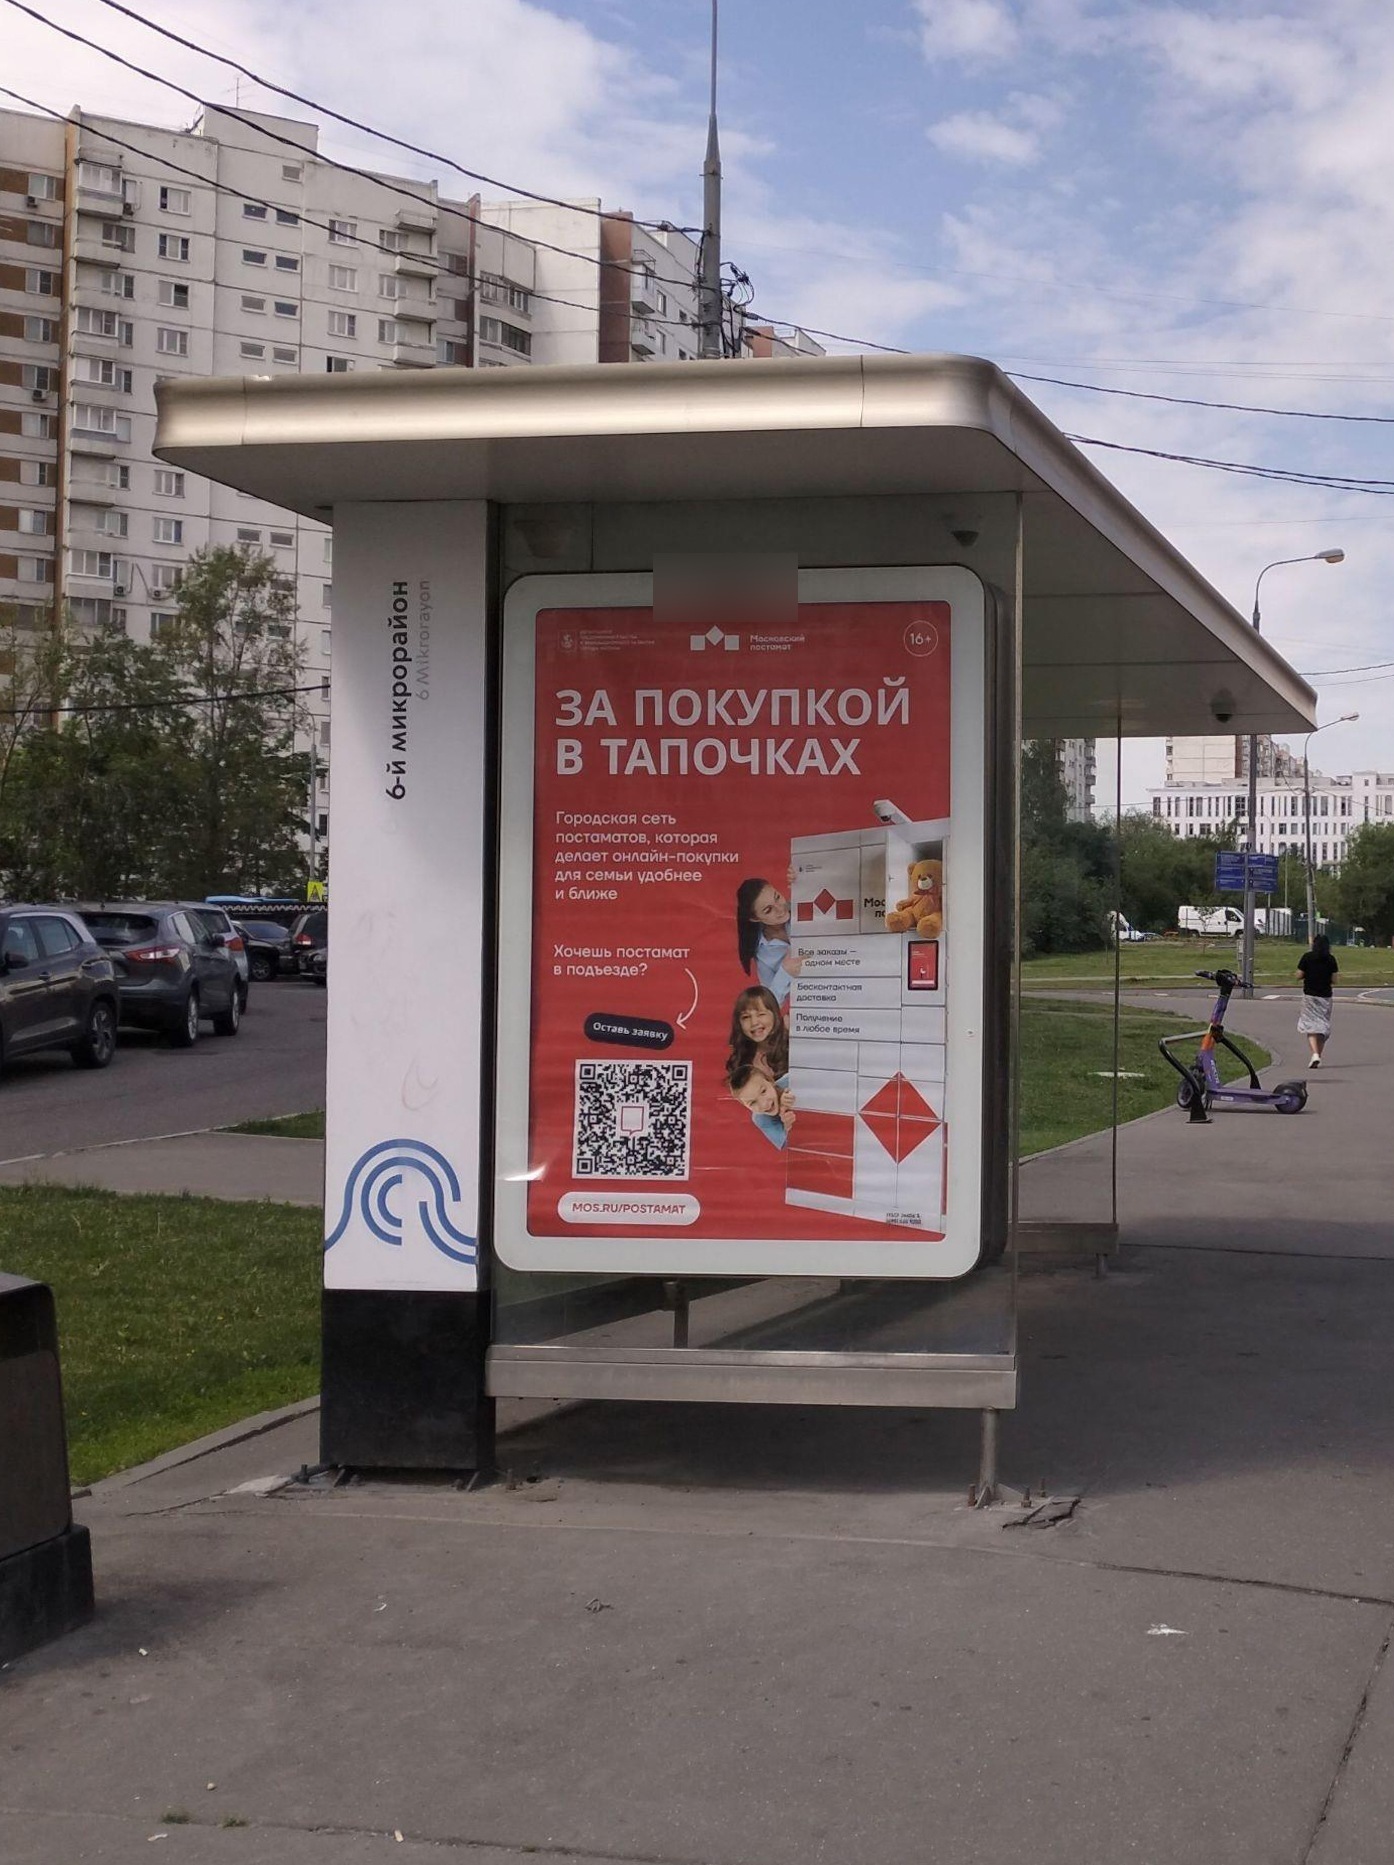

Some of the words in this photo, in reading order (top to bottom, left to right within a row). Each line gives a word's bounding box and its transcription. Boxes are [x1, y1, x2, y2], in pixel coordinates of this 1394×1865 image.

[416, 580, 433, 686] Mikrorayon
[910, 632, 932, 645] 16+
[388, 581, 412, 752] микрорайон
[416, 689, 430, 701] 6
[555, 689, 617, 727] ЗА
[634, 676, 910, 727] ПОКУПКОЙ
[556, 738, 583, 776] В
[600, 737, 861, 776] ТАПОЧКАХ
[385, 761, 406, 800] 6-й
[556, 811, 637, 827] Городская
[641, 813, 677, 825] сеть
[555, 833, 651, 845] постаматов,
[655, 833, 718, 846] которая
[554, 851, 608, 864] делает
[612, 849, 739, 866] онлайн-покупки
[554, 870, 582, 882] для
[585, 870, 633, 882] семьи
[637, 868, 703, 884] удобнее
[555, 889, 565, 900] и
[568, 886, 618, 900] ближе
[553, 944, 612, 958] Хочешь
[616, 948, 690, 958] постамат
[553, 965, 562, 976] в
[566, 962, 648, 977] подъезде?
[593, 1022, 630, 1035] Оставь
[631, 1028, 668, 1042] заявку
[802, 1024, 831, 1033] любое
[572, 1202, 686, 1214] MOS.RU/POSTAMAT
